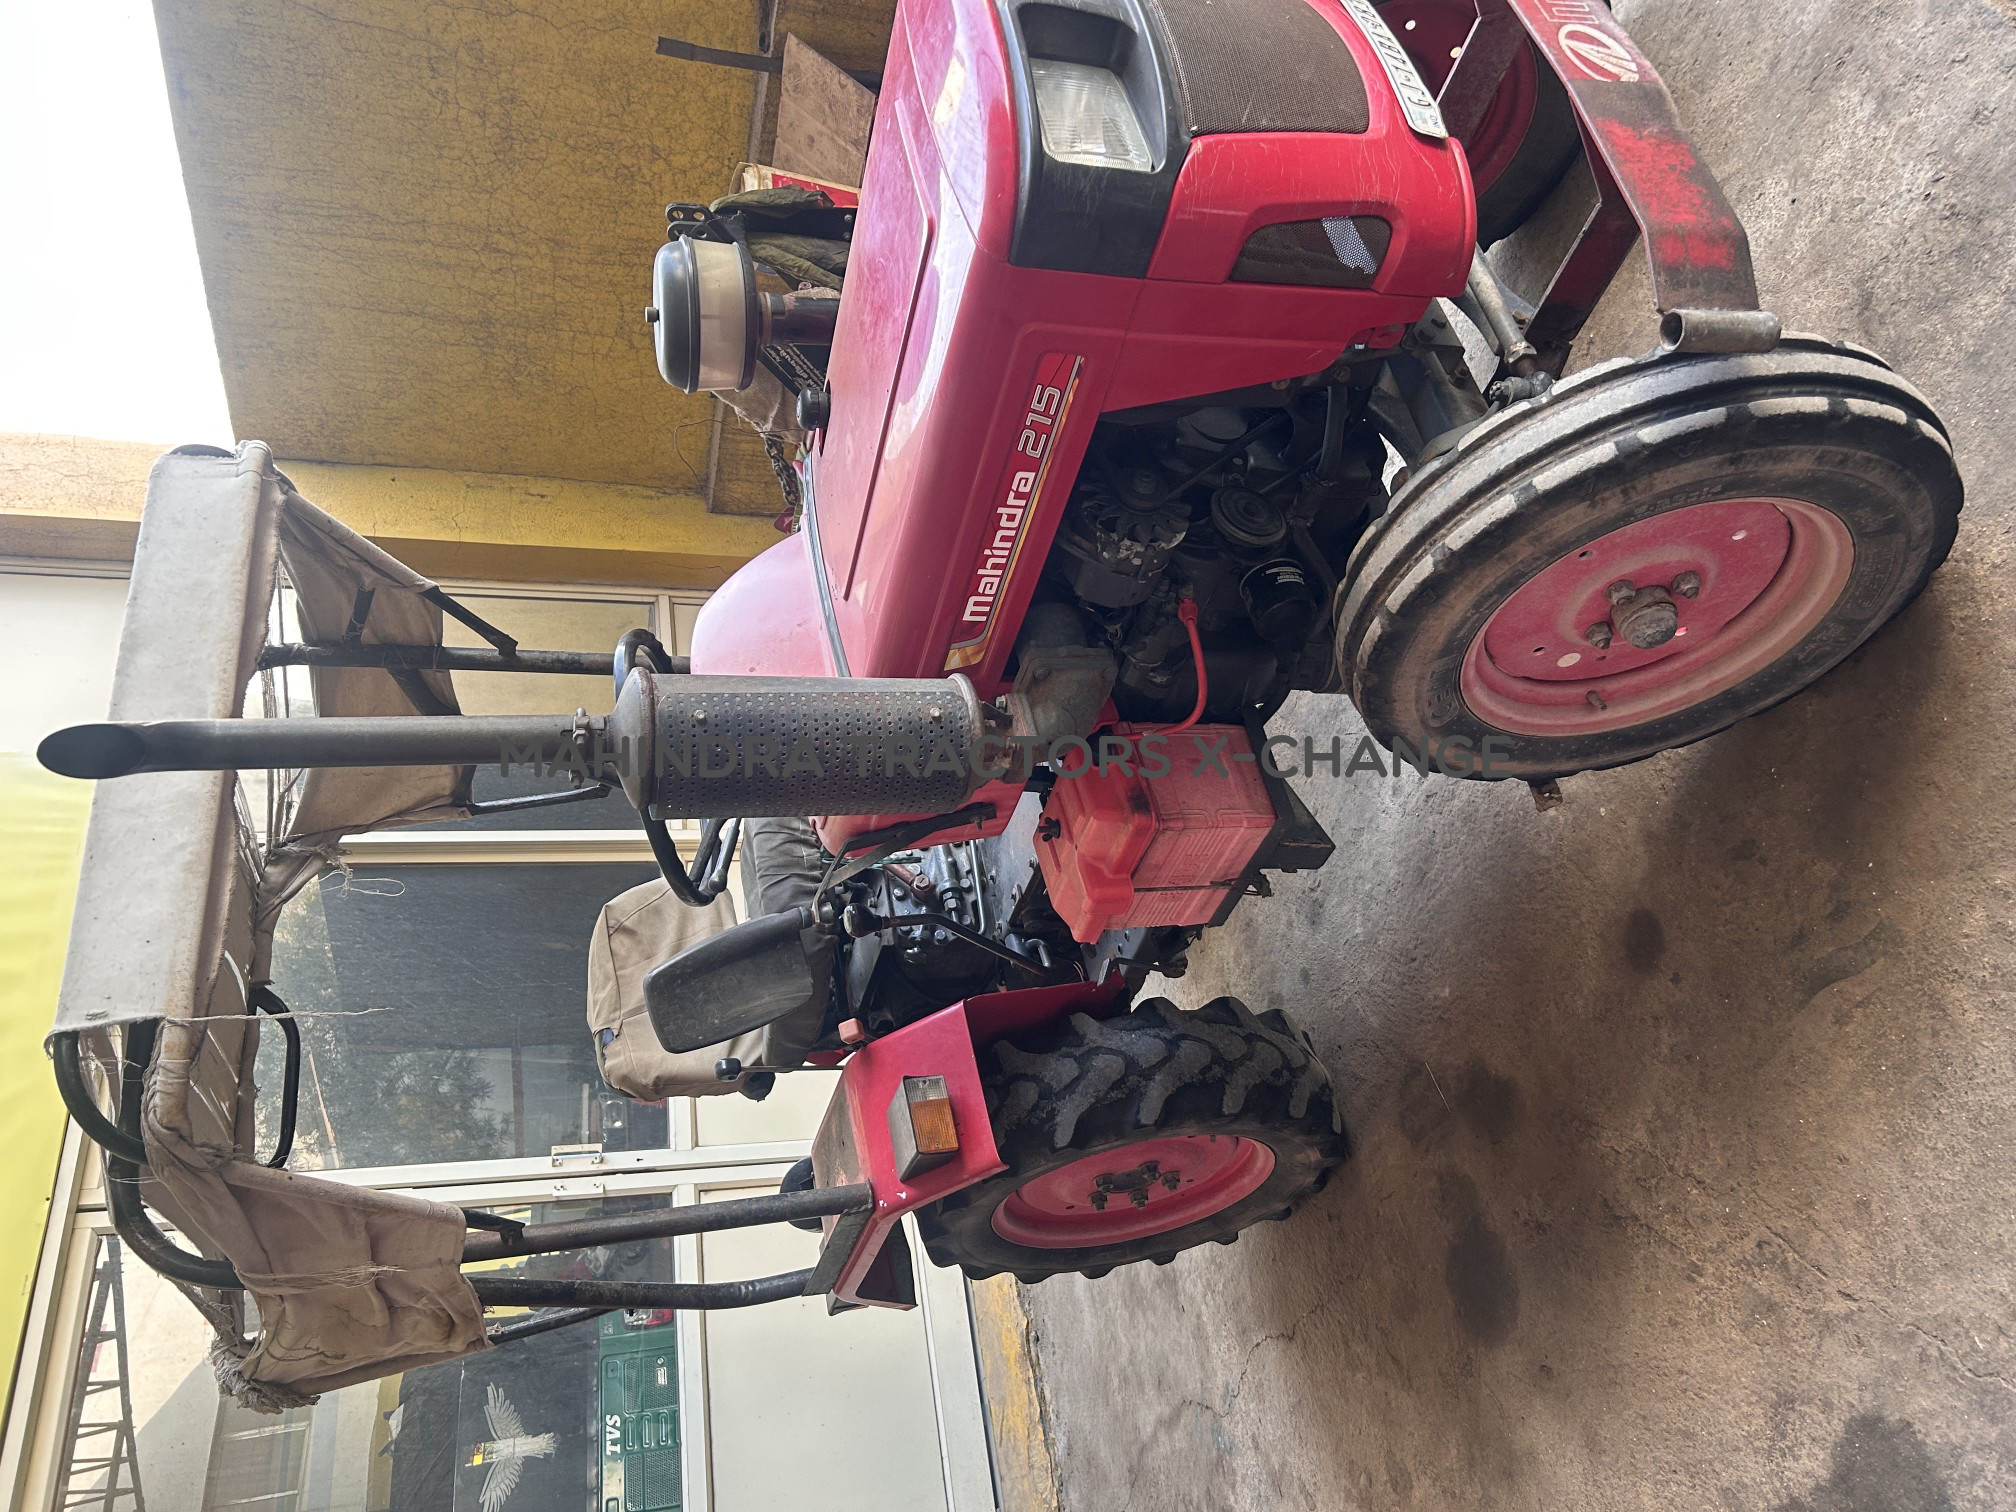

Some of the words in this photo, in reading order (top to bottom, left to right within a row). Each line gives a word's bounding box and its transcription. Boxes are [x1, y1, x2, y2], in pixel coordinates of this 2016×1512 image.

[962, 470, 1037, 622] Mahindra
[1017, 383, 1063, 459] 215
[605, 1414, 621, 1455] TVS
